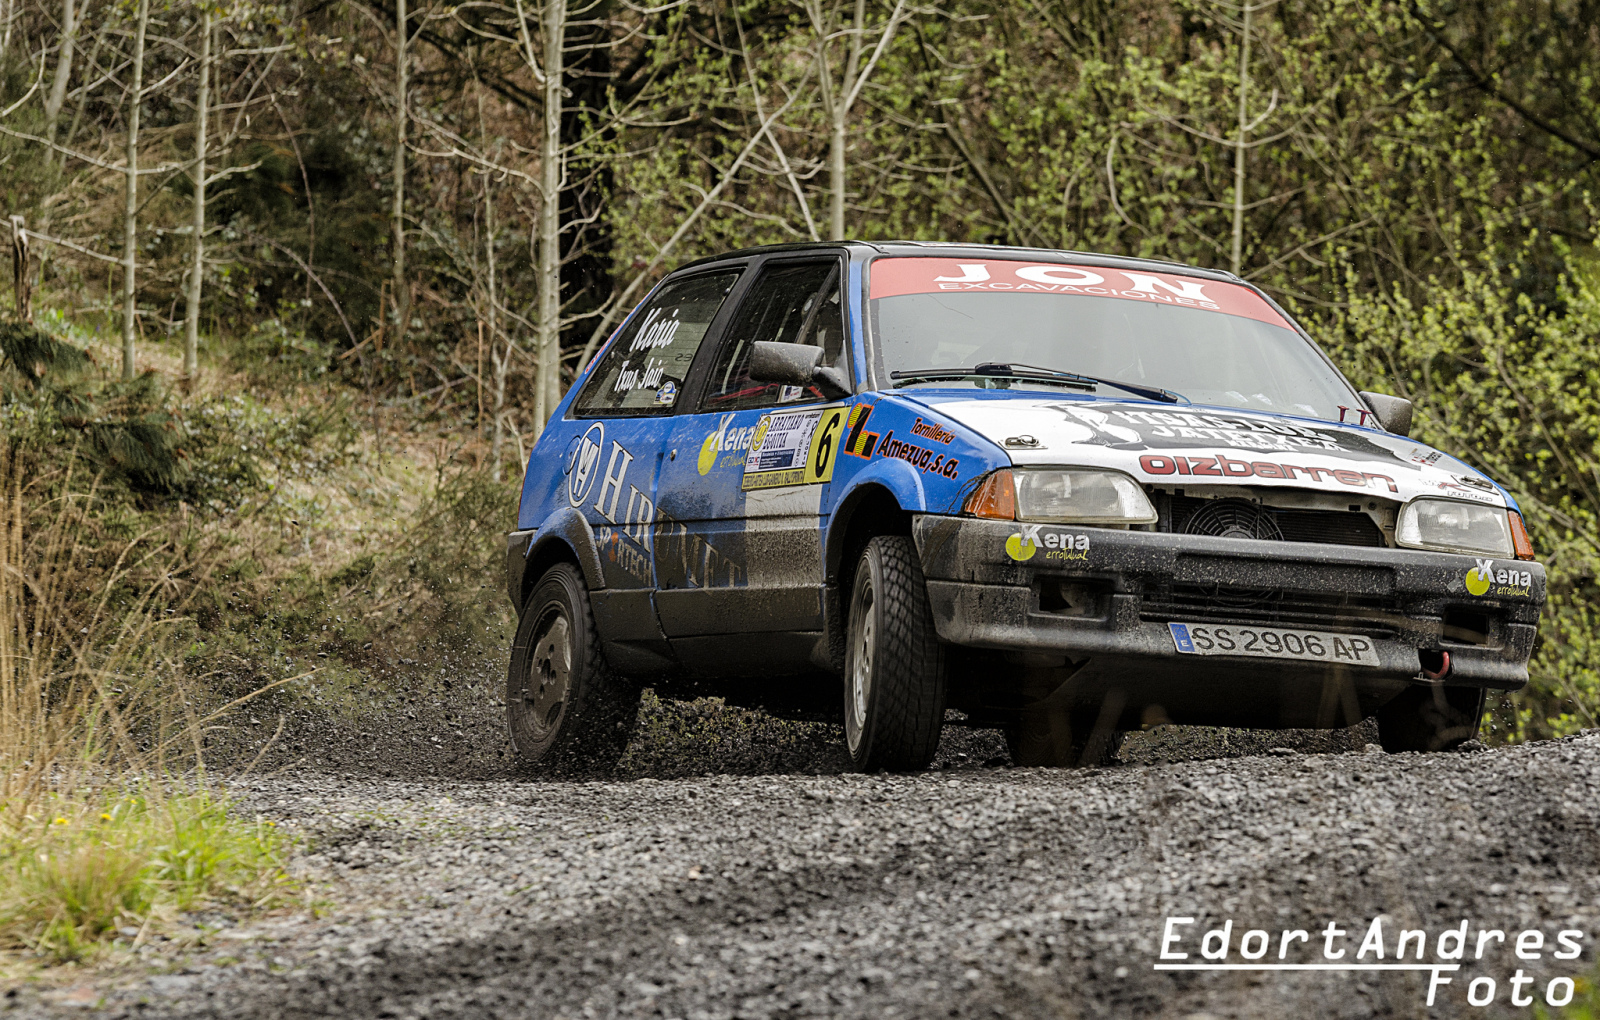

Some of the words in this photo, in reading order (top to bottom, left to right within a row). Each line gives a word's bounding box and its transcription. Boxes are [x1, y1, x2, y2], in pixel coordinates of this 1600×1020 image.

[932, 263, 1216, 303] JON
[938, 282, 1221, 310] EXCAVACIONES
[629, 307, 680, 353] Karia
[815, 412, 841, 478] 6
[1191, 627, 1237, 651] SS
[1239, 629, 1327, 657] 2906
[1333, 637, 1371, 661] AP
